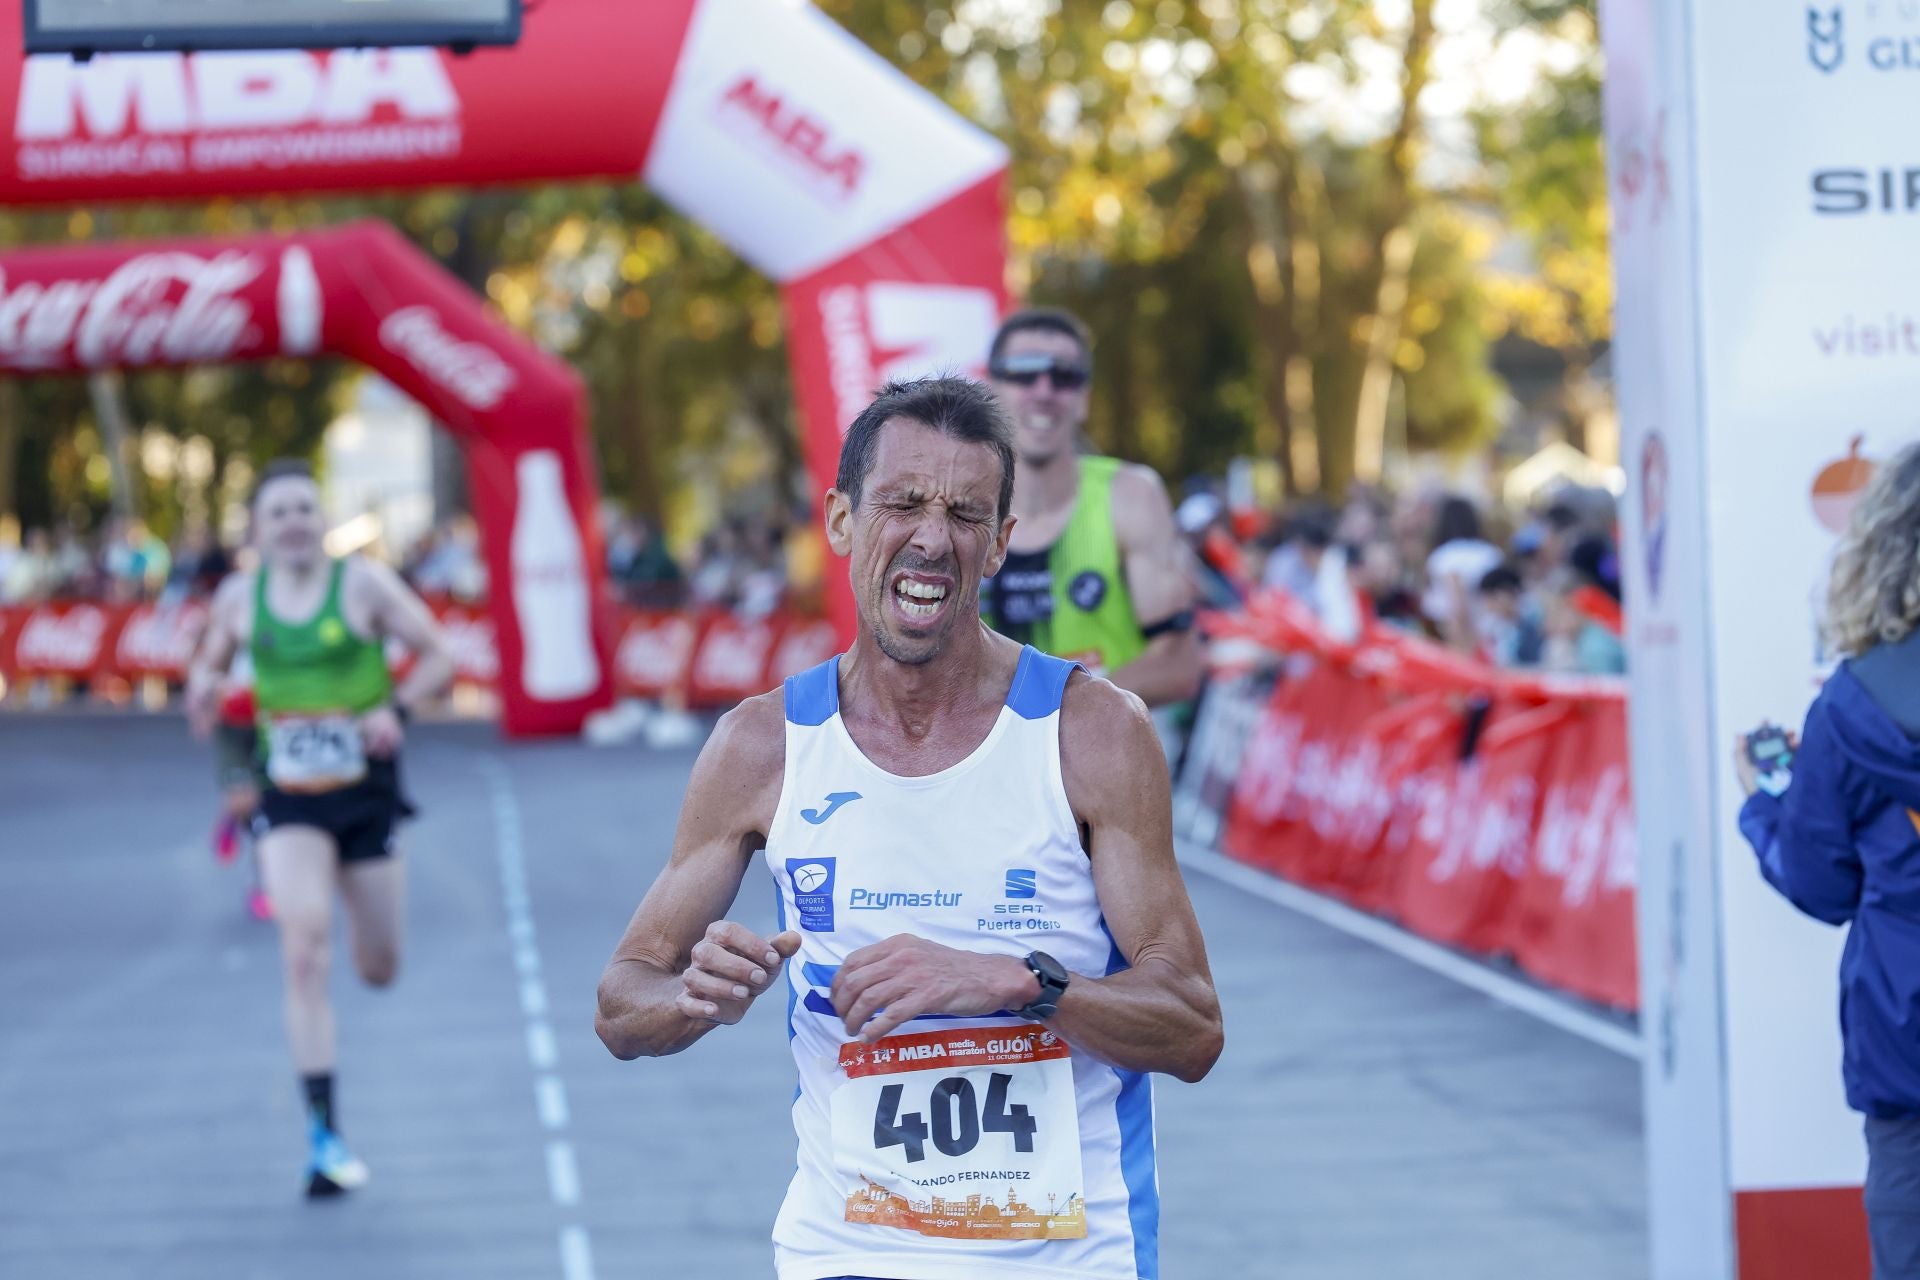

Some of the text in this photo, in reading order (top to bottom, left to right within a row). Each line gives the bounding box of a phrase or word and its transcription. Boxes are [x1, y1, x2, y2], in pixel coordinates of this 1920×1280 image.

[14, 47, 460, 140] MBA
[722, 76, 867, 194] MBA
[849, 888, 962, 910] Prymastur
[993, 904, 1044, 914] SEAT
[977, 918, 1061, 931] Puerta Otero
[898, 1043, 947, 1062] MBA
[948, 1039, 976, 1049] media
[949, 1046, 986, 1057] maratón
[986, 1035, 1033, 1054] GIJÓN
[873, 1072, 1037, 1164] 404
[958, 1170, 1031, 1182] FERNANDEZ
